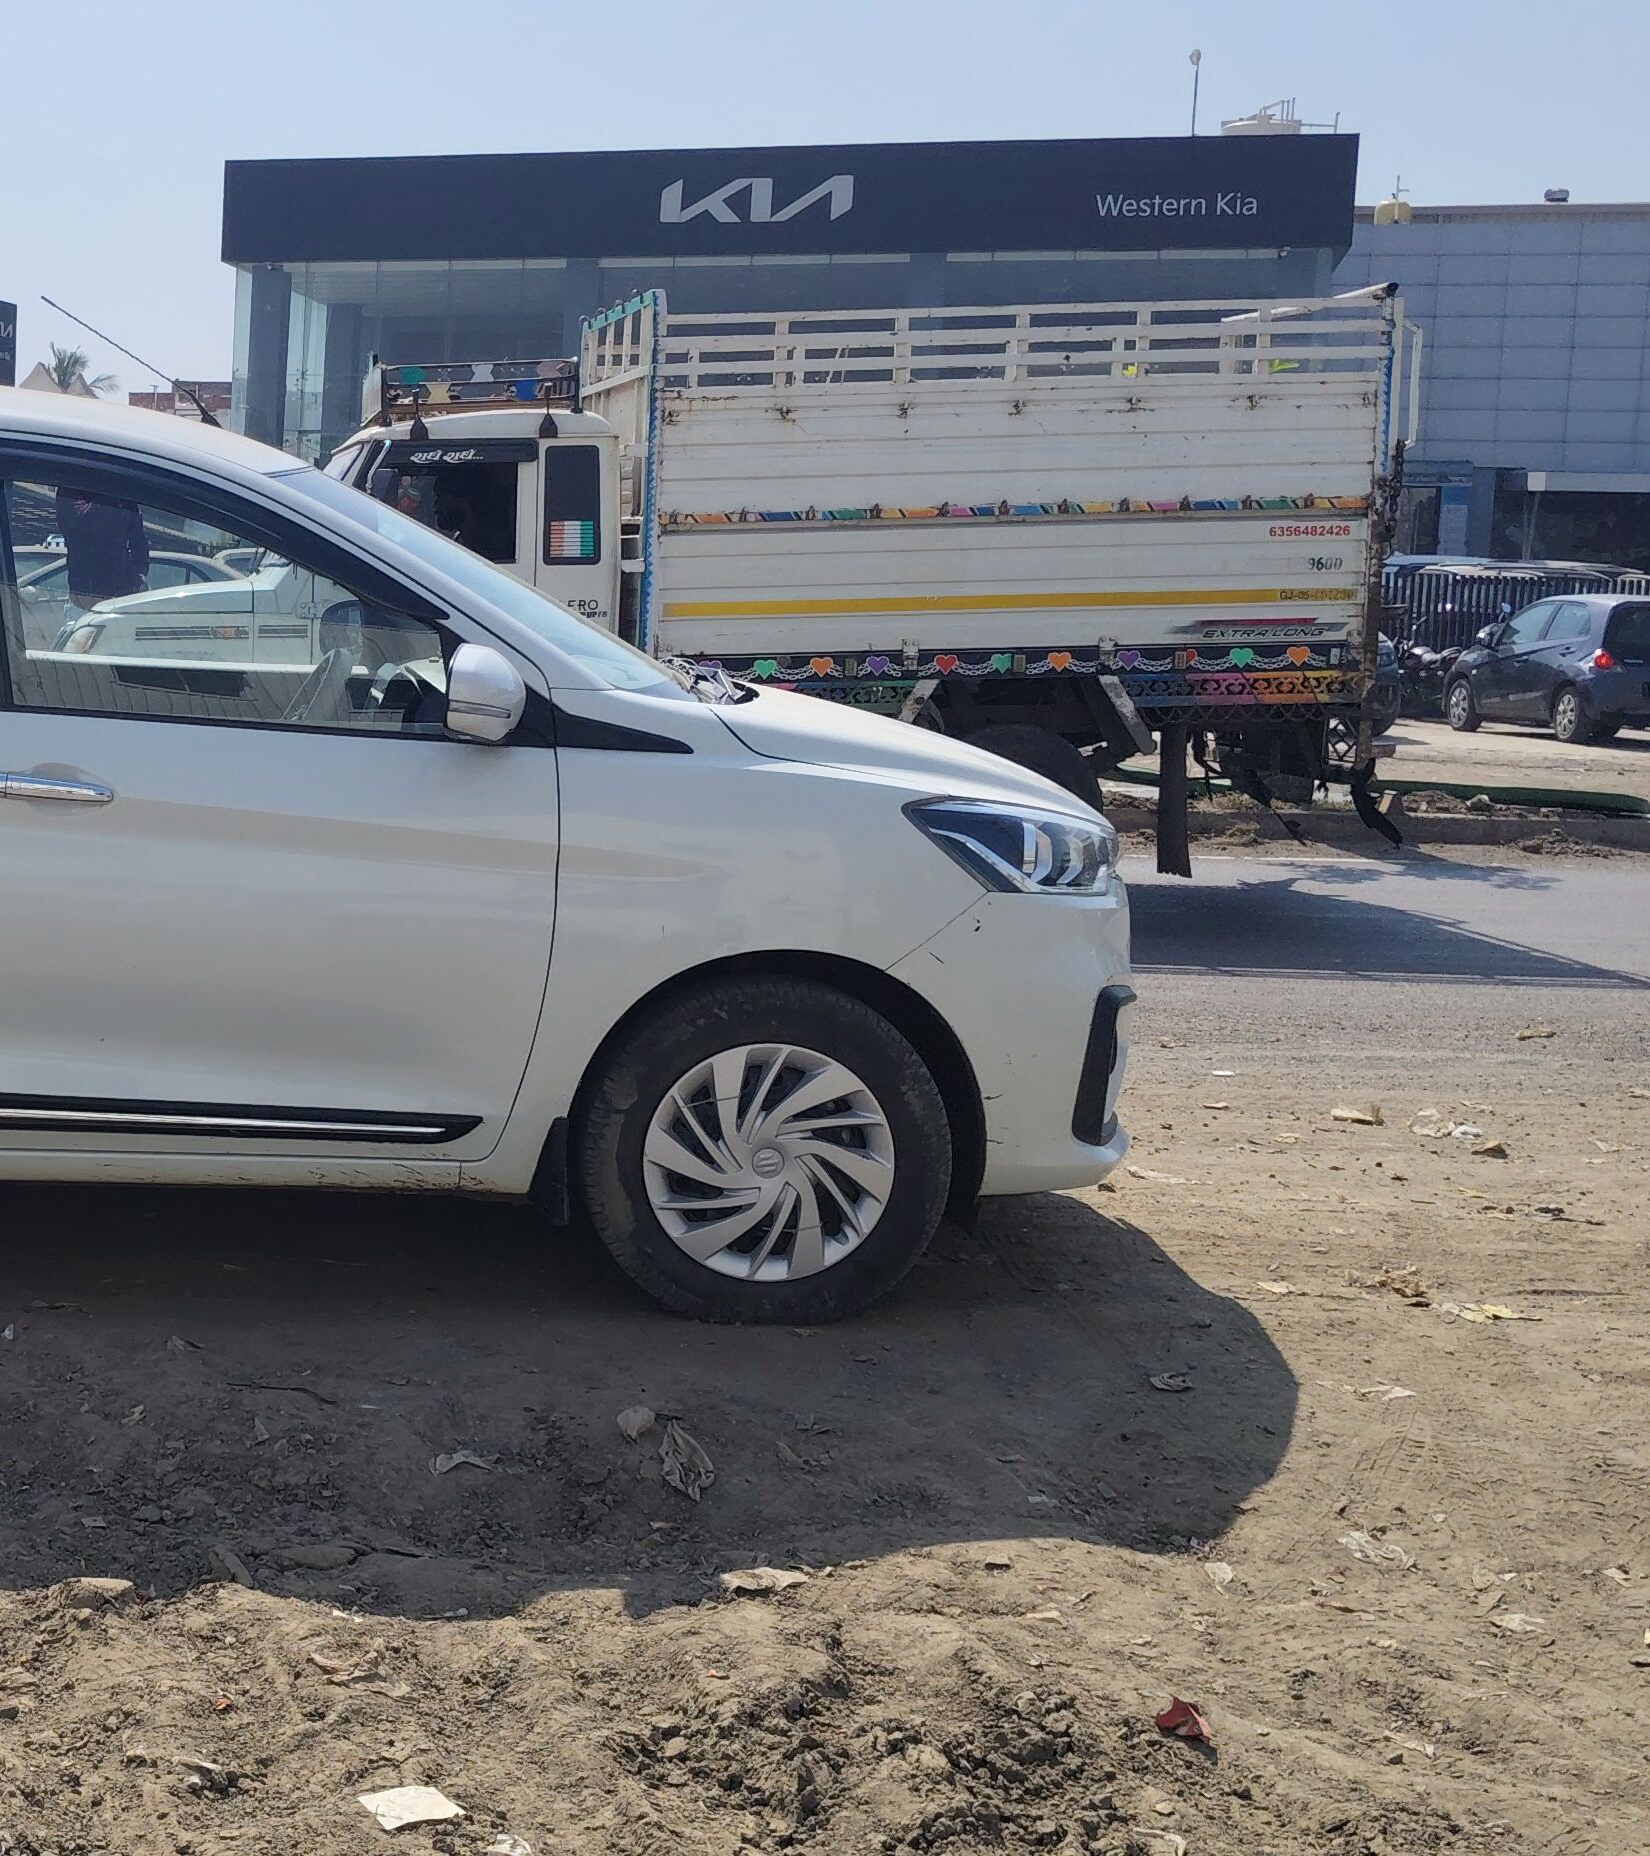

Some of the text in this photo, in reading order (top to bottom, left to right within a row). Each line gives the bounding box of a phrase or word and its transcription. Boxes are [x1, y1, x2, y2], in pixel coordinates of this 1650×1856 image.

[659, 173, 854, 223] KIA
[1096, 191, 1258, 217] Western Kia
[1269, 525, 1351, 537] 6356482426
[566, 599, 599, 611] ERO
